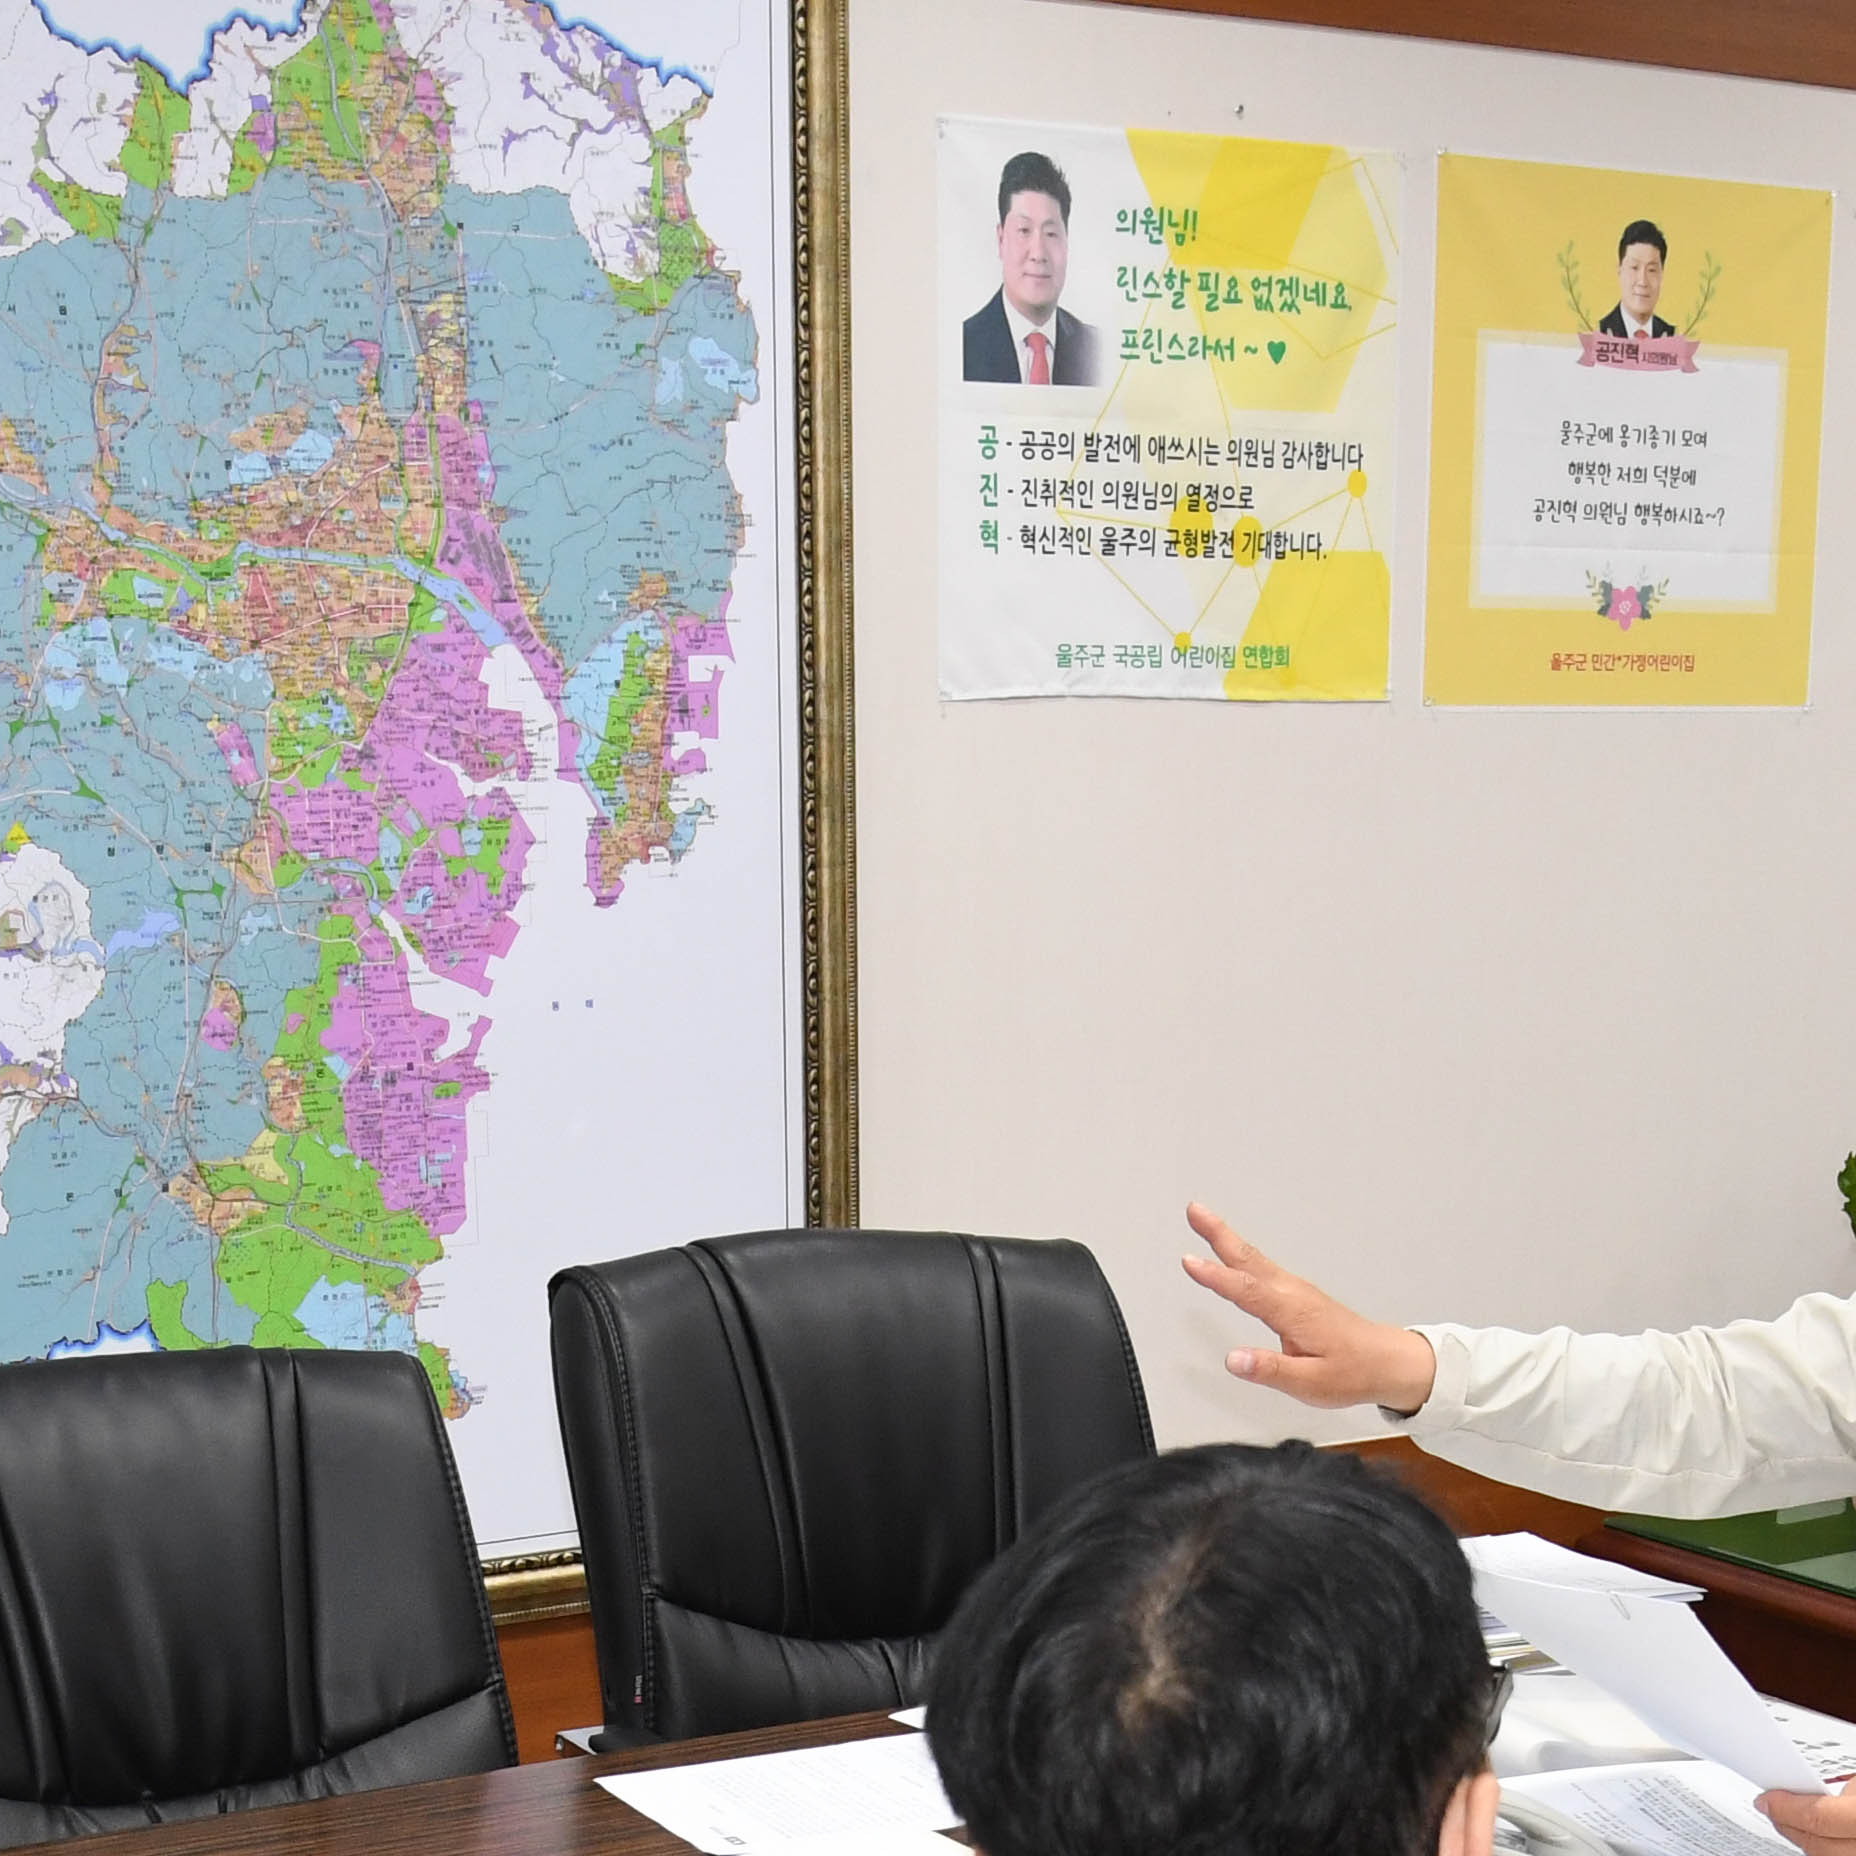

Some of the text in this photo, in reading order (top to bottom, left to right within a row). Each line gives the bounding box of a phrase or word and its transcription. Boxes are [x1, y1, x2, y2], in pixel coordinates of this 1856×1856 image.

[1115, 206, 1198, 247] 의원님!
[1116, 266, 1191, 310] 린스할
[1197, 272, 1243, 312] 필요
[1119, 328, 1235, 364] 프린스라서
[1595, 339, 1640, 364] 공진혁
[977, 425, 1364, 472] 공 공공의 발전에 애쓰시는 의원님 감사합니다
[1560, 420, 1708, 450] 울주군에 옹기종기 모여
[1568, 460, 1697, 489] 행복한 저희 덕분에
[978, 473, 1255, 513] 진 진취적인 의원님의 열정으로
[1532, 498, 1578, 524] 공진혁
[1583, 501, 1628, 527] 의원님
[978, 520, 1328, 561] 혁 혁신적인 울주의 균형발전 기대합니다.
[1055, 643, 1291, 670] 울주군 국공립 어린이집 연합회
[1550, 652, 1587, 673] 울주군
